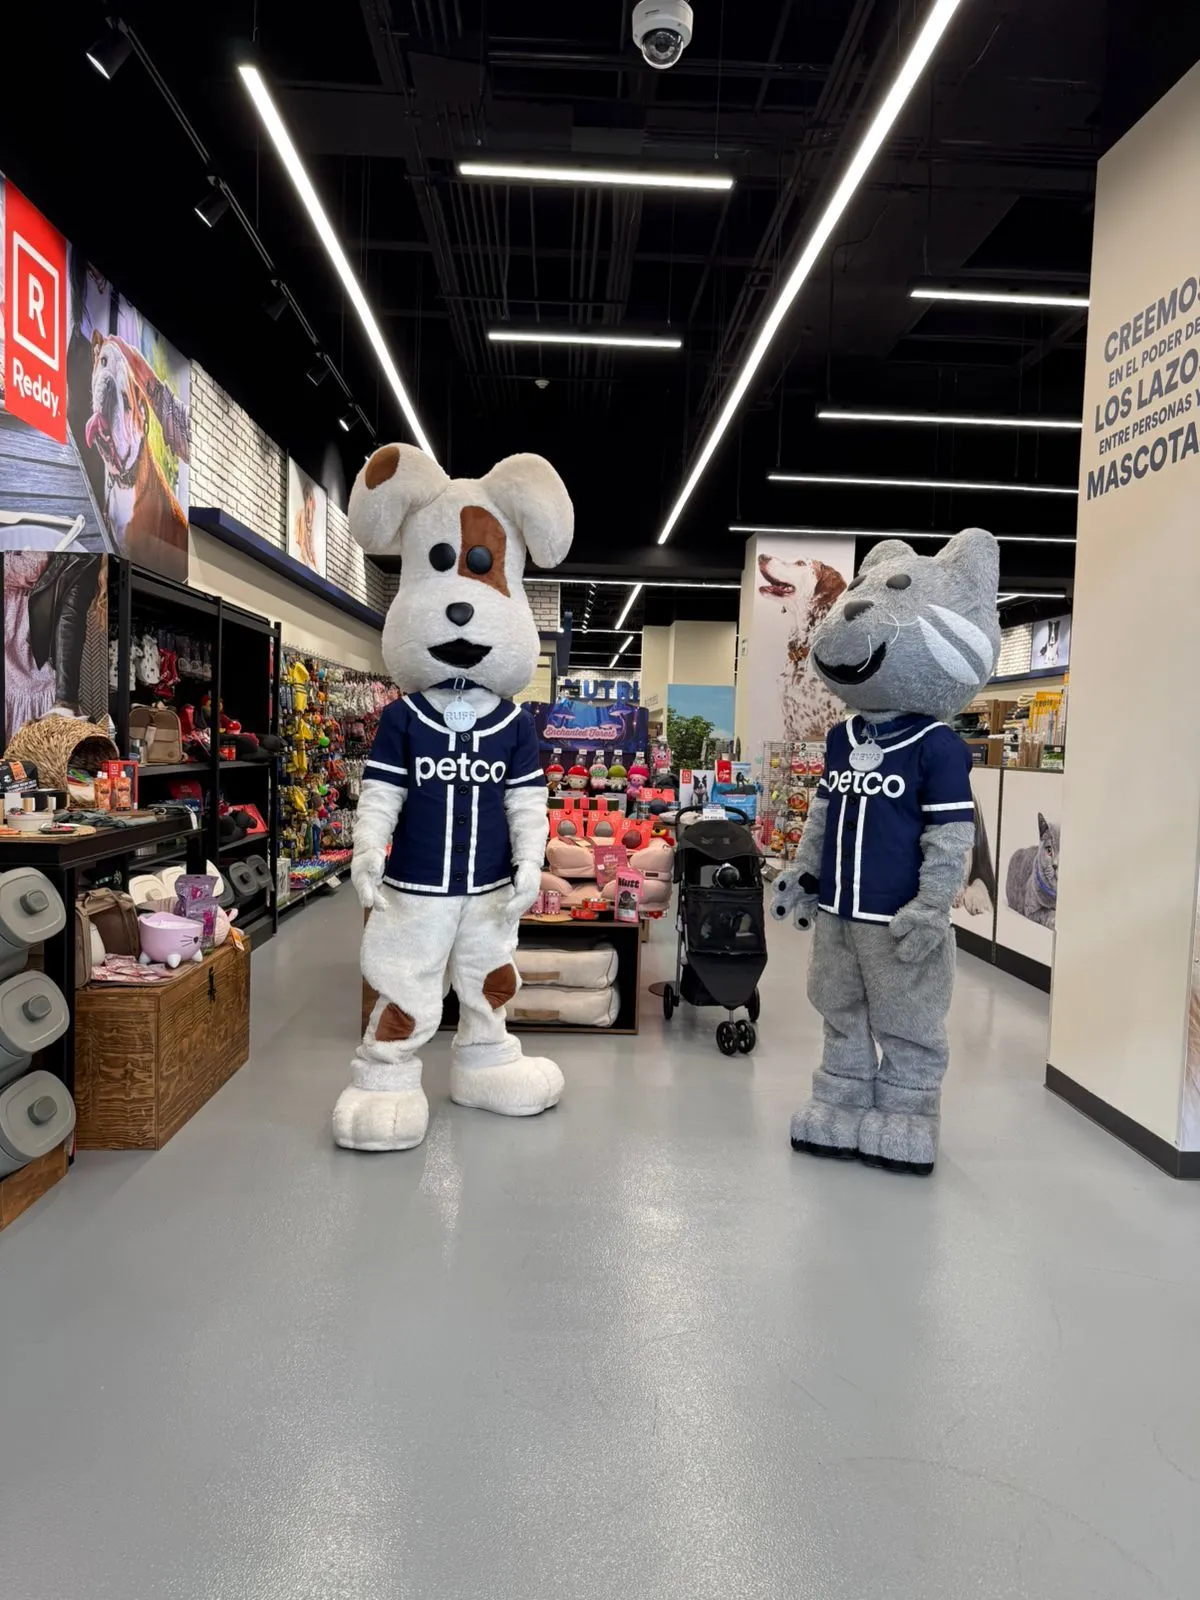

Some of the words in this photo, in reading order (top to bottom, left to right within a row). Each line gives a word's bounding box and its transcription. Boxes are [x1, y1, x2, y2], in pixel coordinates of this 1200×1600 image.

[28, 273, 46, 339] R
[1103, 276, 1200, 363] CREEMO
[13, 357, 59, 418] Reddy
[1108, 365, 1123, 389] EN
[1126, 356, 1139, 380] EL
[1141, 328, 1182, 369] PODER
[1094, 386, 1132, 434] LOS
[1137, 348, 1200, 410] LAZO
[1099, 425, 1130, 456] ENTRE
[1132, 392, 1192, 439] PERSONAS
[1087, 421, 1200, 501] MASCOTA
[445, 711, 475, 721] RUFF
[415, 752, 506, 787] petco
